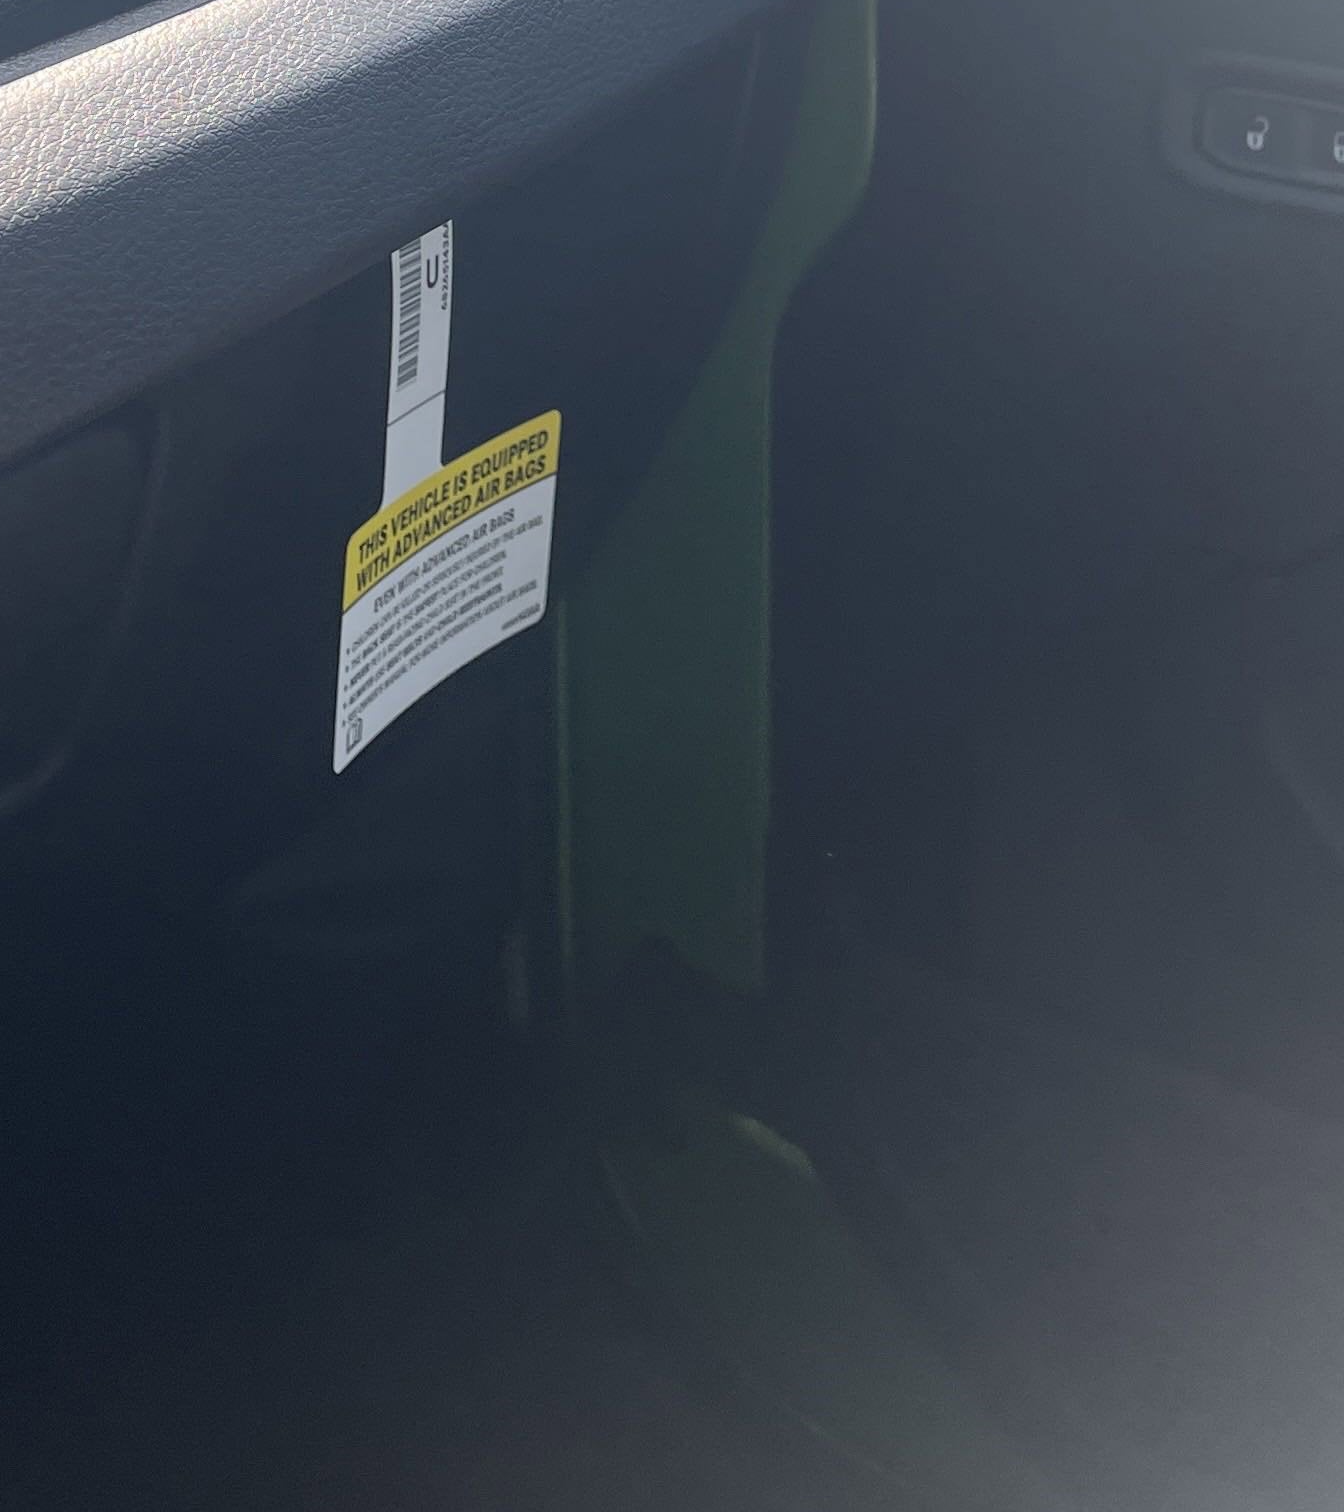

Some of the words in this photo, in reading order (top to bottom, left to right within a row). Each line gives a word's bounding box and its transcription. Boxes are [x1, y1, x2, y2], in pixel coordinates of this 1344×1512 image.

[356, 552, 390, 591] WITH
[392, 495, 471, 563] ADVANCED
[474, 479, 500, 507] AIR
[505, 455, 546, 490] BAGS
[359, 524, 387, 564] THIS
[391, 481, 450, 535] VEHICLE
[454, 470, 467, 496] IS
[471, 430, 549, 484] EQUIPPED
